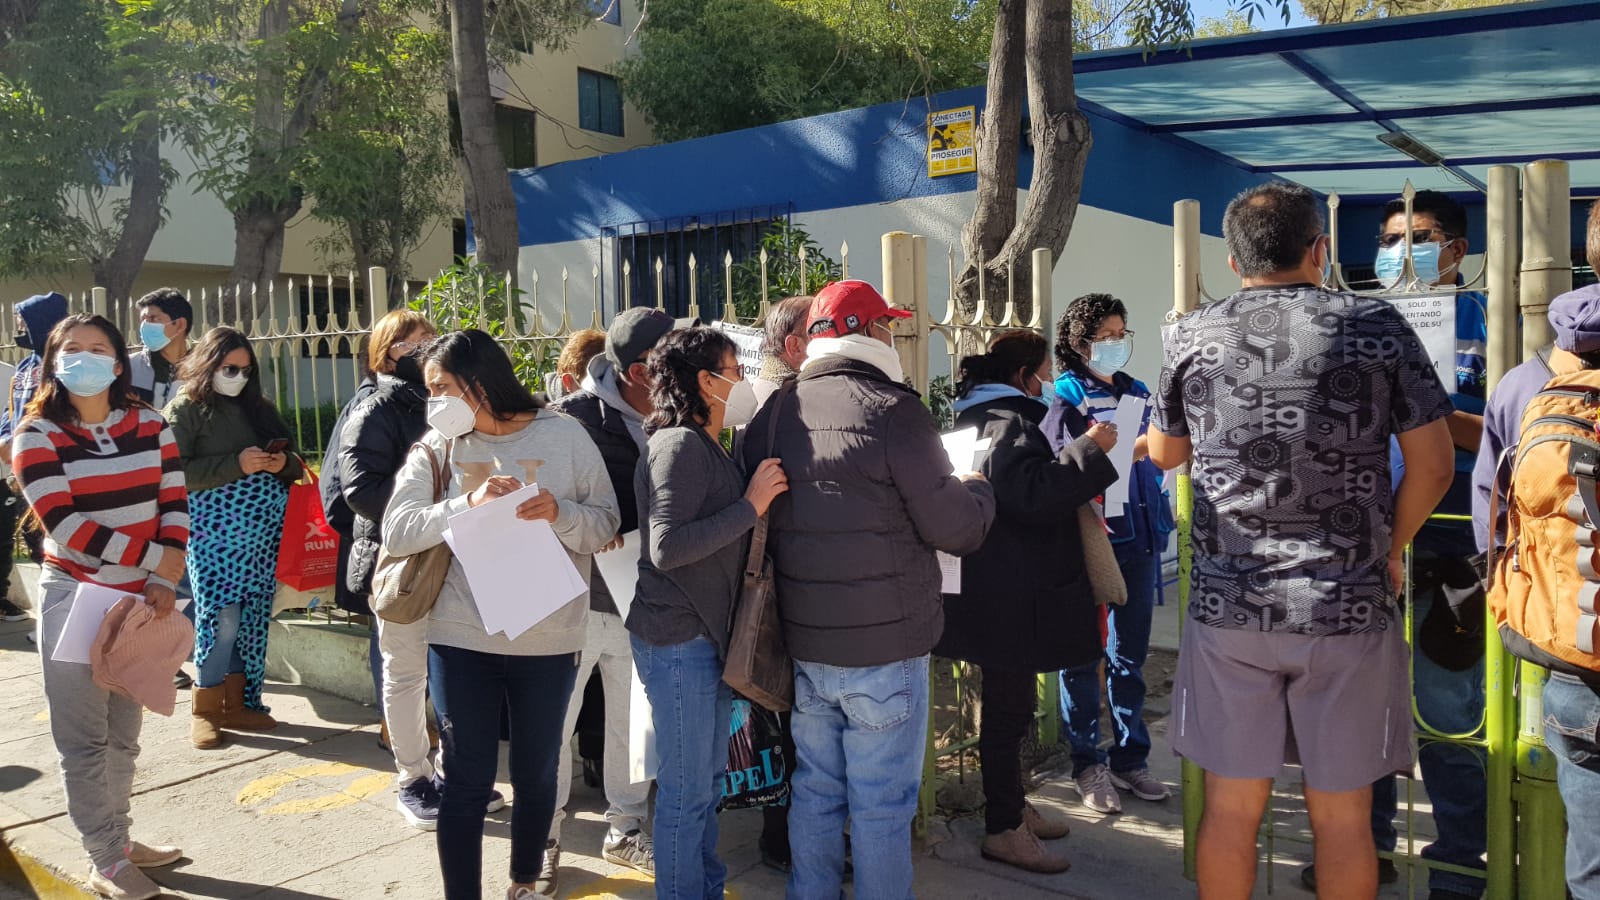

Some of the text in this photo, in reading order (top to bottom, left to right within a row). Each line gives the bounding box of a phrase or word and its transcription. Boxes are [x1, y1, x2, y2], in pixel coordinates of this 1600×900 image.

[931, 147, 973, 160] PROSEGUR
[1404, 311, 1442, 319] ENTANDO
[304, 539, 336, 552] RUN
